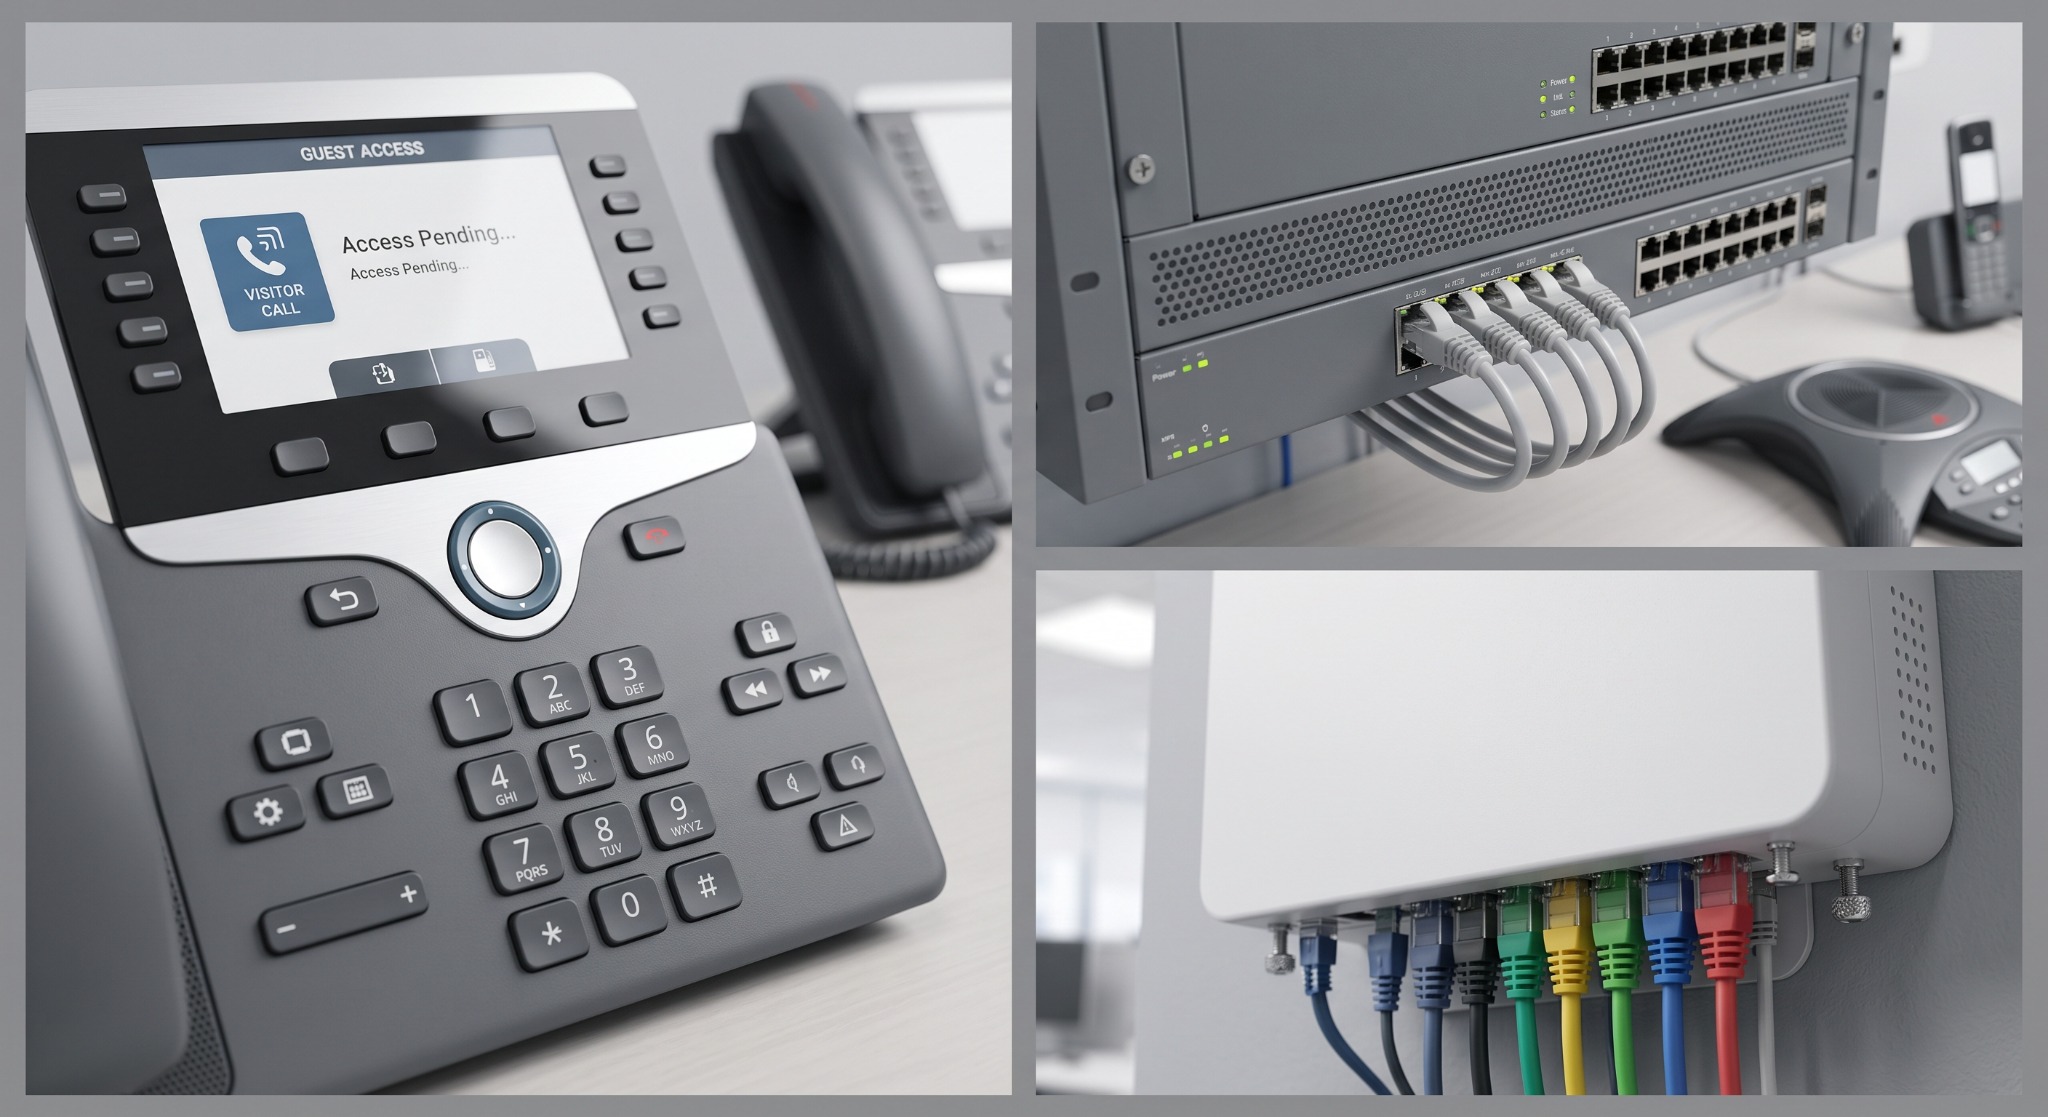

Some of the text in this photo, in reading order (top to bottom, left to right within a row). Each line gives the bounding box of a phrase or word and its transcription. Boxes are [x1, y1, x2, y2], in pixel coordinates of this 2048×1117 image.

[1550, 78, 1568, 87] Power
[301, 141, 424, 161] GUEST ACCESS
[342, 225, 516, 254] Access Pending...
[350, 259, 470, 281] Access Pending...
[244, 284, 305, 301] VISITOR
[261, 302, 301, 317] CALL
[618, 657, 637, 681] 3
[542, 674, 564, 700] 2
[625, 682, 645, 696] DEF
[465, 693, 481, 718] 1
[549, 699, 572, 714] ABC
[645, 724, 663, 750] 6
[568, 743, 588, 770] 5
[648, 751, 674, 765] MNO
[491, 763, 510, 790] 4
[577, 771, 597, 785] JKL
[496, 791, 518, 805] GHI
[670, 795, 688, 821] 9
[594, 816, 614, 842] 8
[671, 819, 703, 836] WXYZ
[512, 837, 530, 865] 7
[600, 843, 622, 857] TUV
[516, 864, 548, 882] PQRS
[697, 872, 718, 899] #
[621, 891, 640, 918] 0
